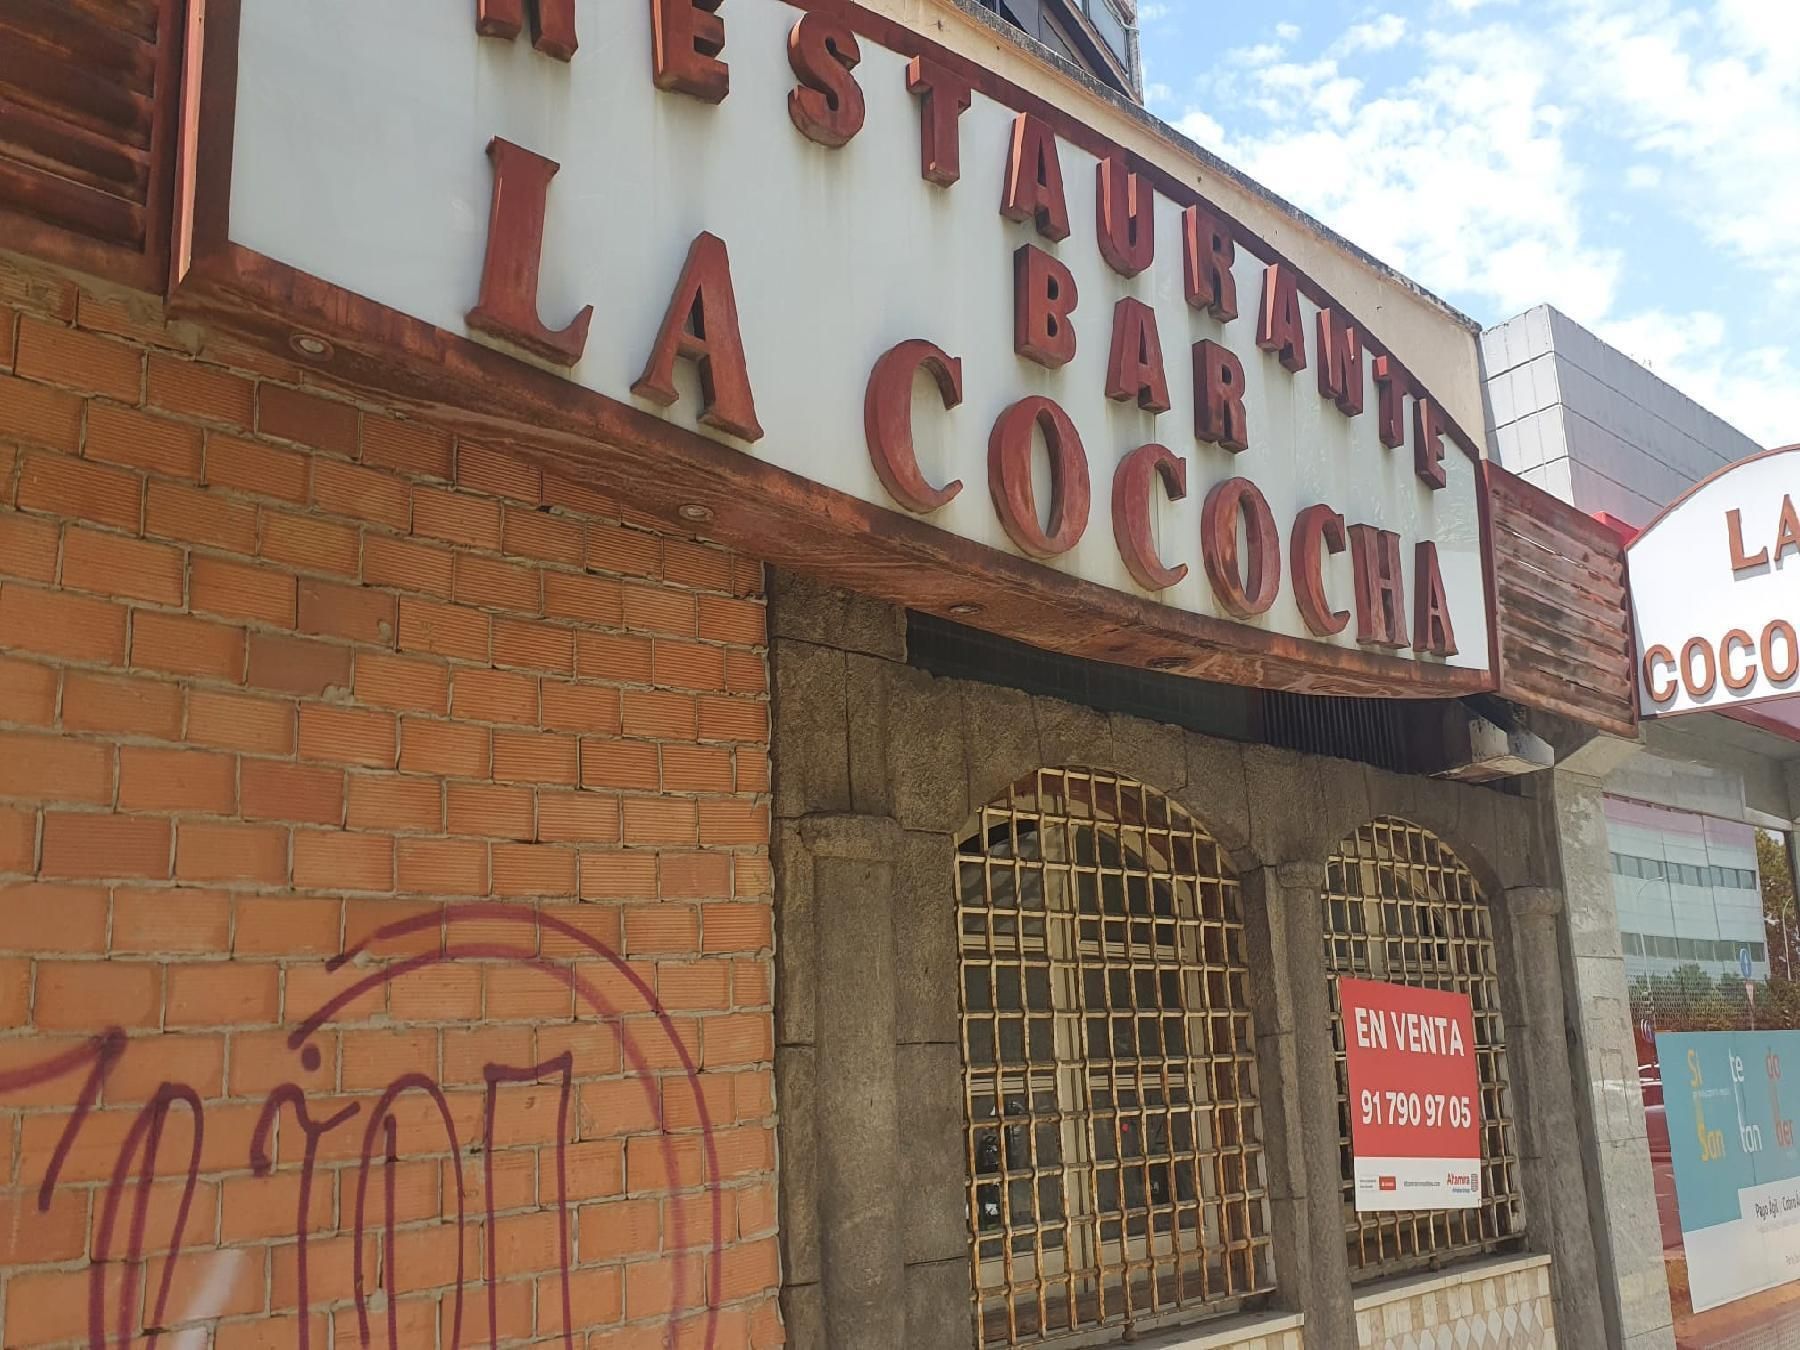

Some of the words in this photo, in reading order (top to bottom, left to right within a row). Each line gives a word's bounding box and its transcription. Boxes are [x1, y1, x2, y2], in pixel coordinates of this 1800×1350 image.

[1014, 244, 1248, 454] BAR
[465, 136, 764, 443] LA
[864, 338, 1459, 656] COCOCHA
[1725, 494, 1800, 574] LA
[1643, 619, 1799, 703] COCO
[1354, 1007, 1388, 1049] EN
[1390, 1012, 1464, 1057] VENTA
[1361, 1089, 1382, 1125] 91
[1385, 1092, 1421, 1127] 790
[1425, 1094, 1446, 1127] 97
[1450, 1095, 1471, 1128] 05
